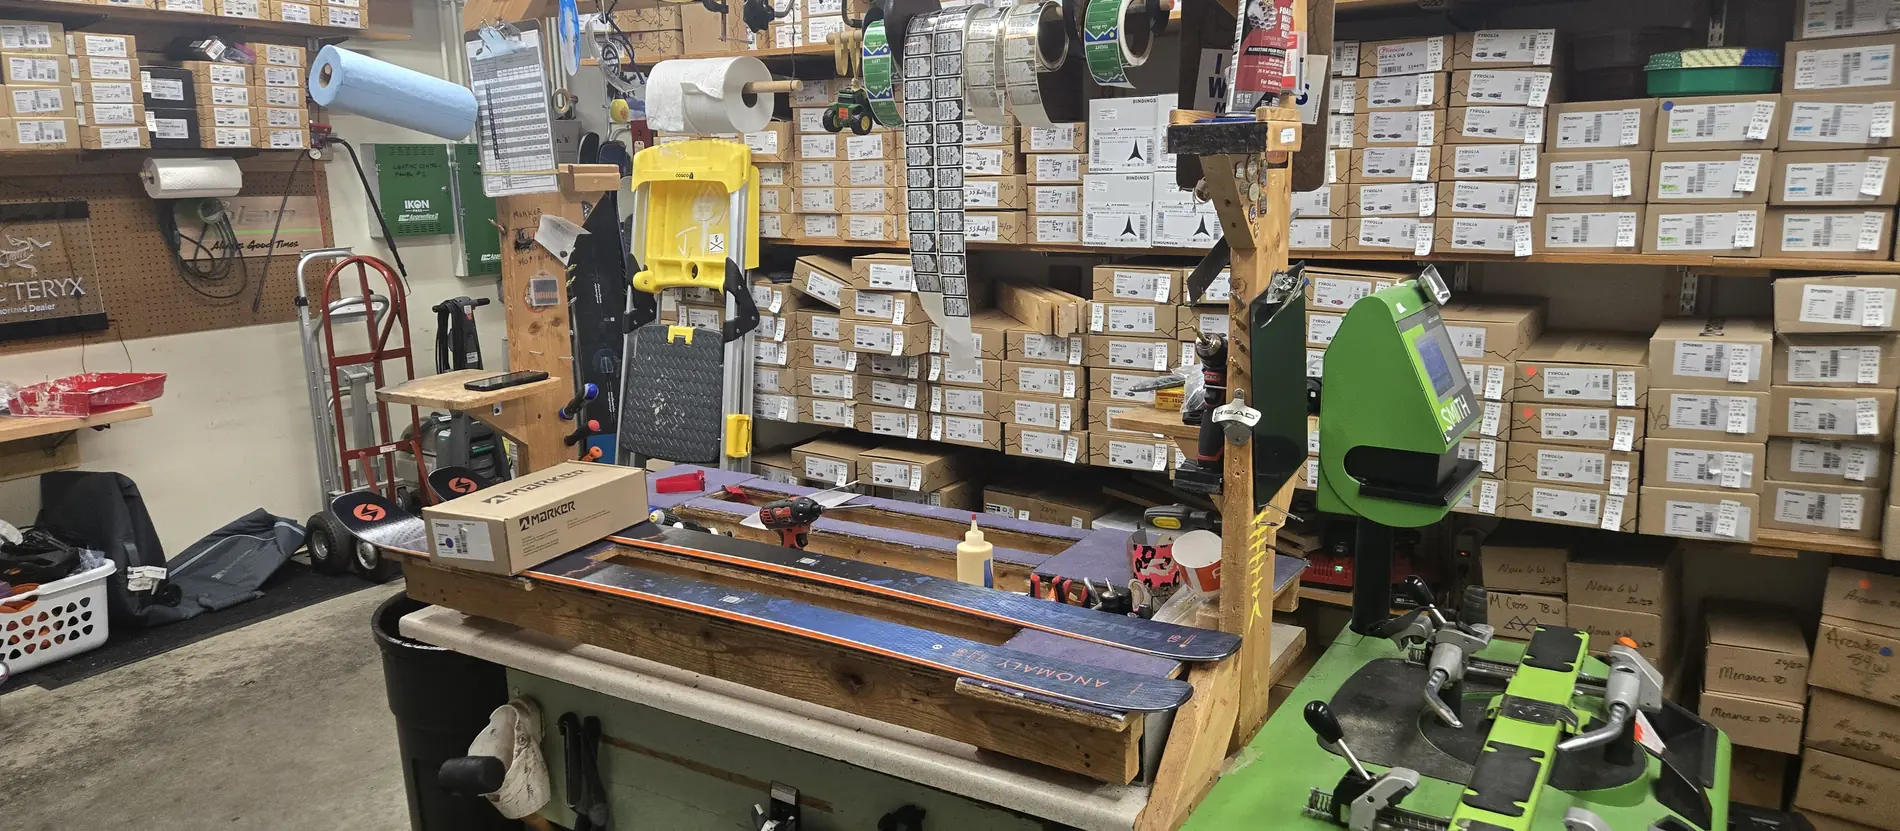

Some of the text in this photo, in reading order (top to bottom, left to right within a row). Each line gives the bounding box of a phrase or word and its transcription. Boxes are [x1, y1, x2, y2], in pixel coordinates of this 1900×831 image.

[404, 199, 430, 210] IKON
[513, 207, 542, 219] MARKER
[275, 239, 300, 249] Times
[29, 303, 56, 312] Dealer
[1214, 409, 1255, 420] HEAD
[1440, 394, 1471, 429] SMITH
[505, 468, 593, 498] MARKER
[531, 500, 576, 527] MARKER
[1497, 563, 1524, 574] Nova
[1584, 580, 1614, 593] Nova
[1627, 583, 1639, 593] W
[1489, 594, 1501, 609] M
[1506, 596, 1529, 611] Cross
[996, 659, 1109, 689] ANOMALY
